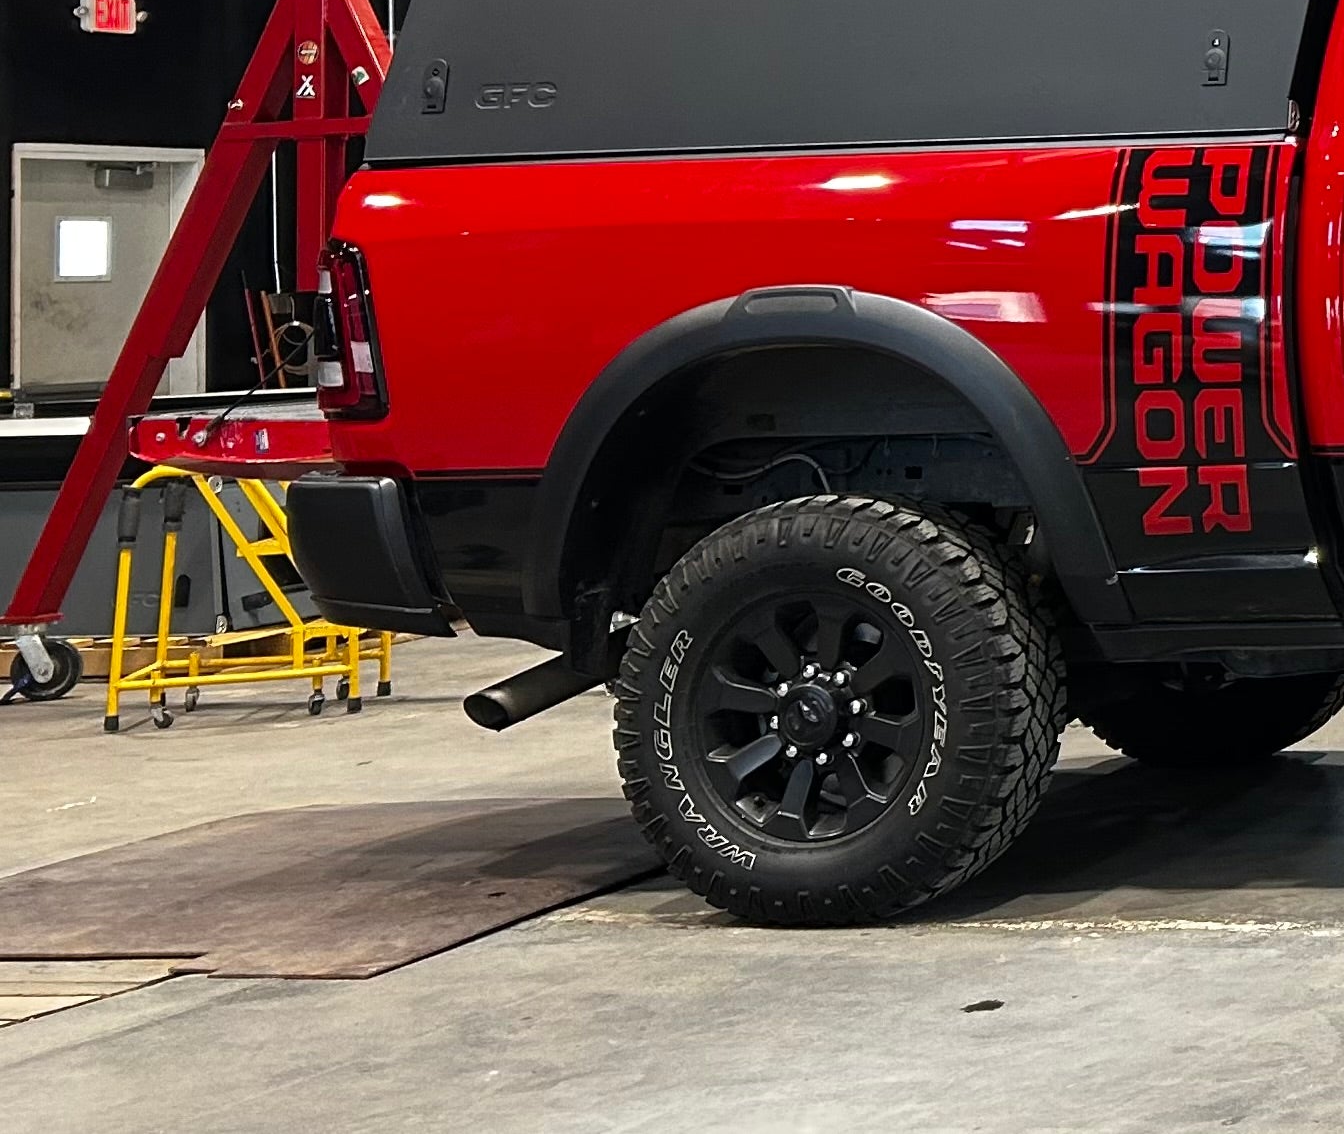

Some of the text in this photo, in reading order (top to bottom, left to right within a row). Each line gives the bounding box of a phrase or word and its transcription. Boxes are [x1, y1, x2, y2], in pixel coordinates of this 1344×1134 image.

[475, 82, 557, 110] GFC
[1132, 149, 1195, 536] WAGON
[1192, 148, 1254, 533] POWER
[652, 629, 757, 871] WRANGLER
[836, 567, 949, 817] GOODYEAR
